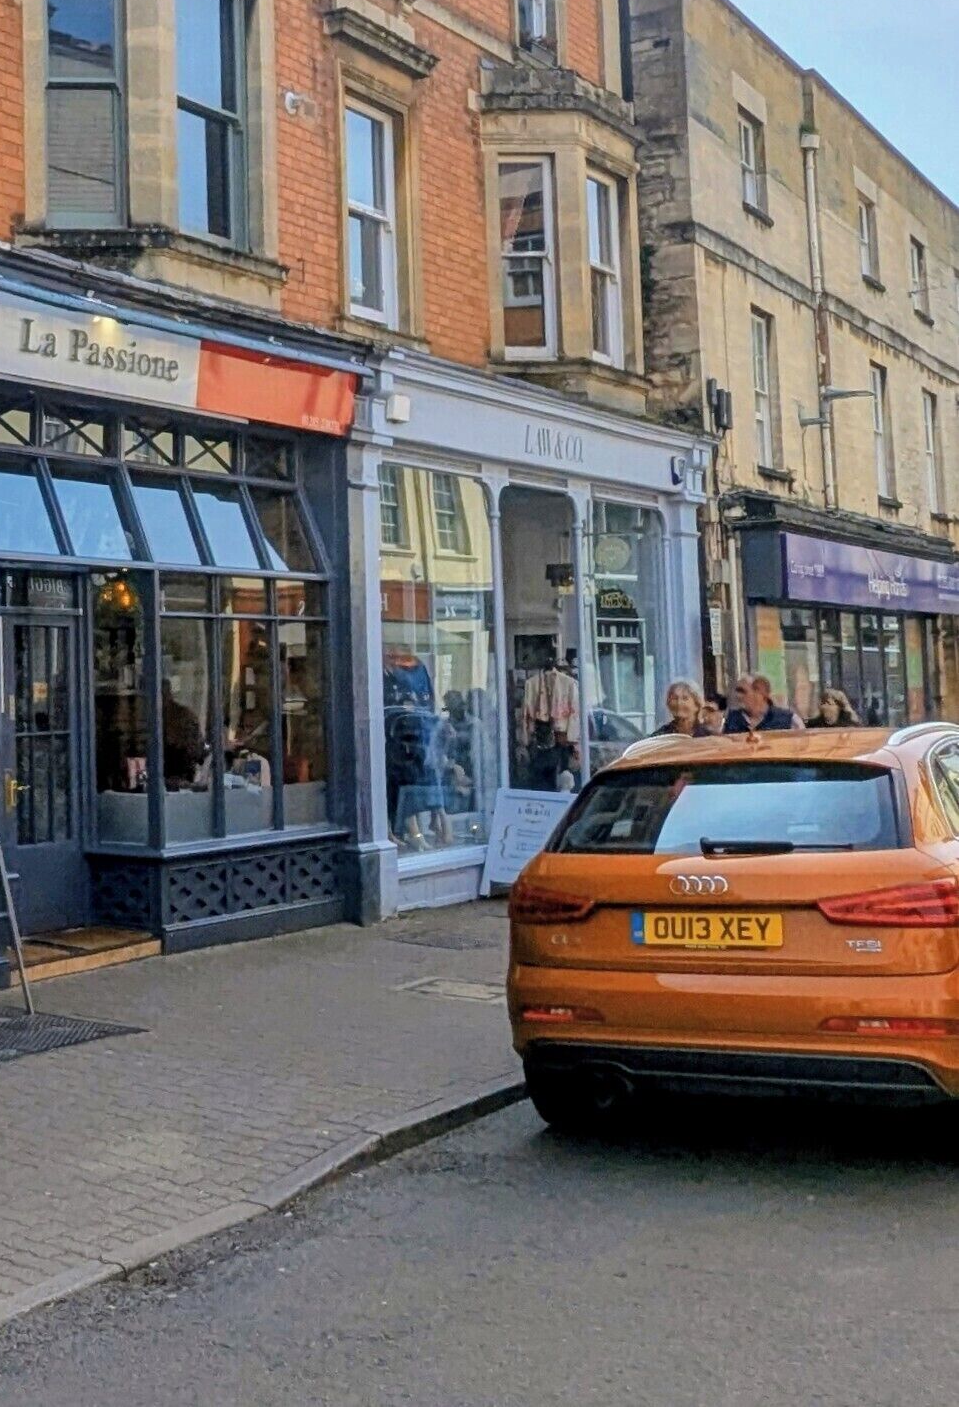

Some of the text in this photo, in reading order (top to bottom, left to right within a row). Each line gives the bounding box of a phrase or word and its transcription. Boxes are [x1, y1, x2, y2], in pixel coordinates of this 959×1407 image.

[19, 317, 180, 382] La Passione
[653, 916, 771, 941] OU13 XEY
